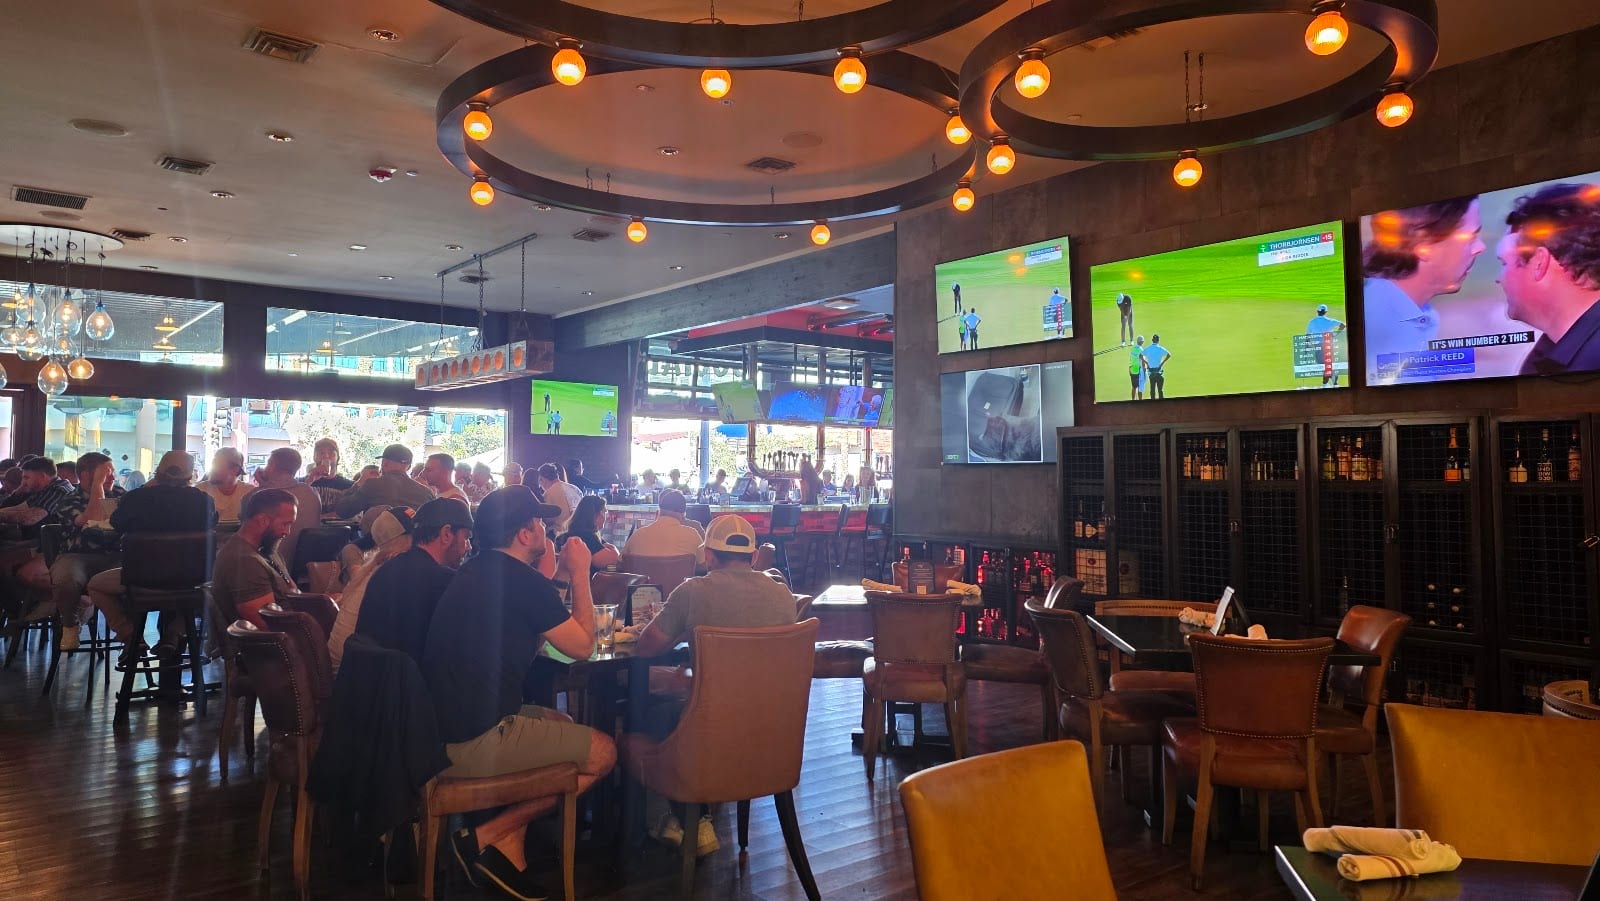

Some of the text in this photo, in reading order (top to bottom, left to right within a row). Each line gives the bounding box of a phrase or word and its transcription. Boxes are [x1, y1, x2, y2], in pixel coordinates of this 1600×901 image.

[1432, 333, 1528, 350] IT'S WIN NUMBER 2 THIS
[1409, 352, 1465, 363] Patrick REED
